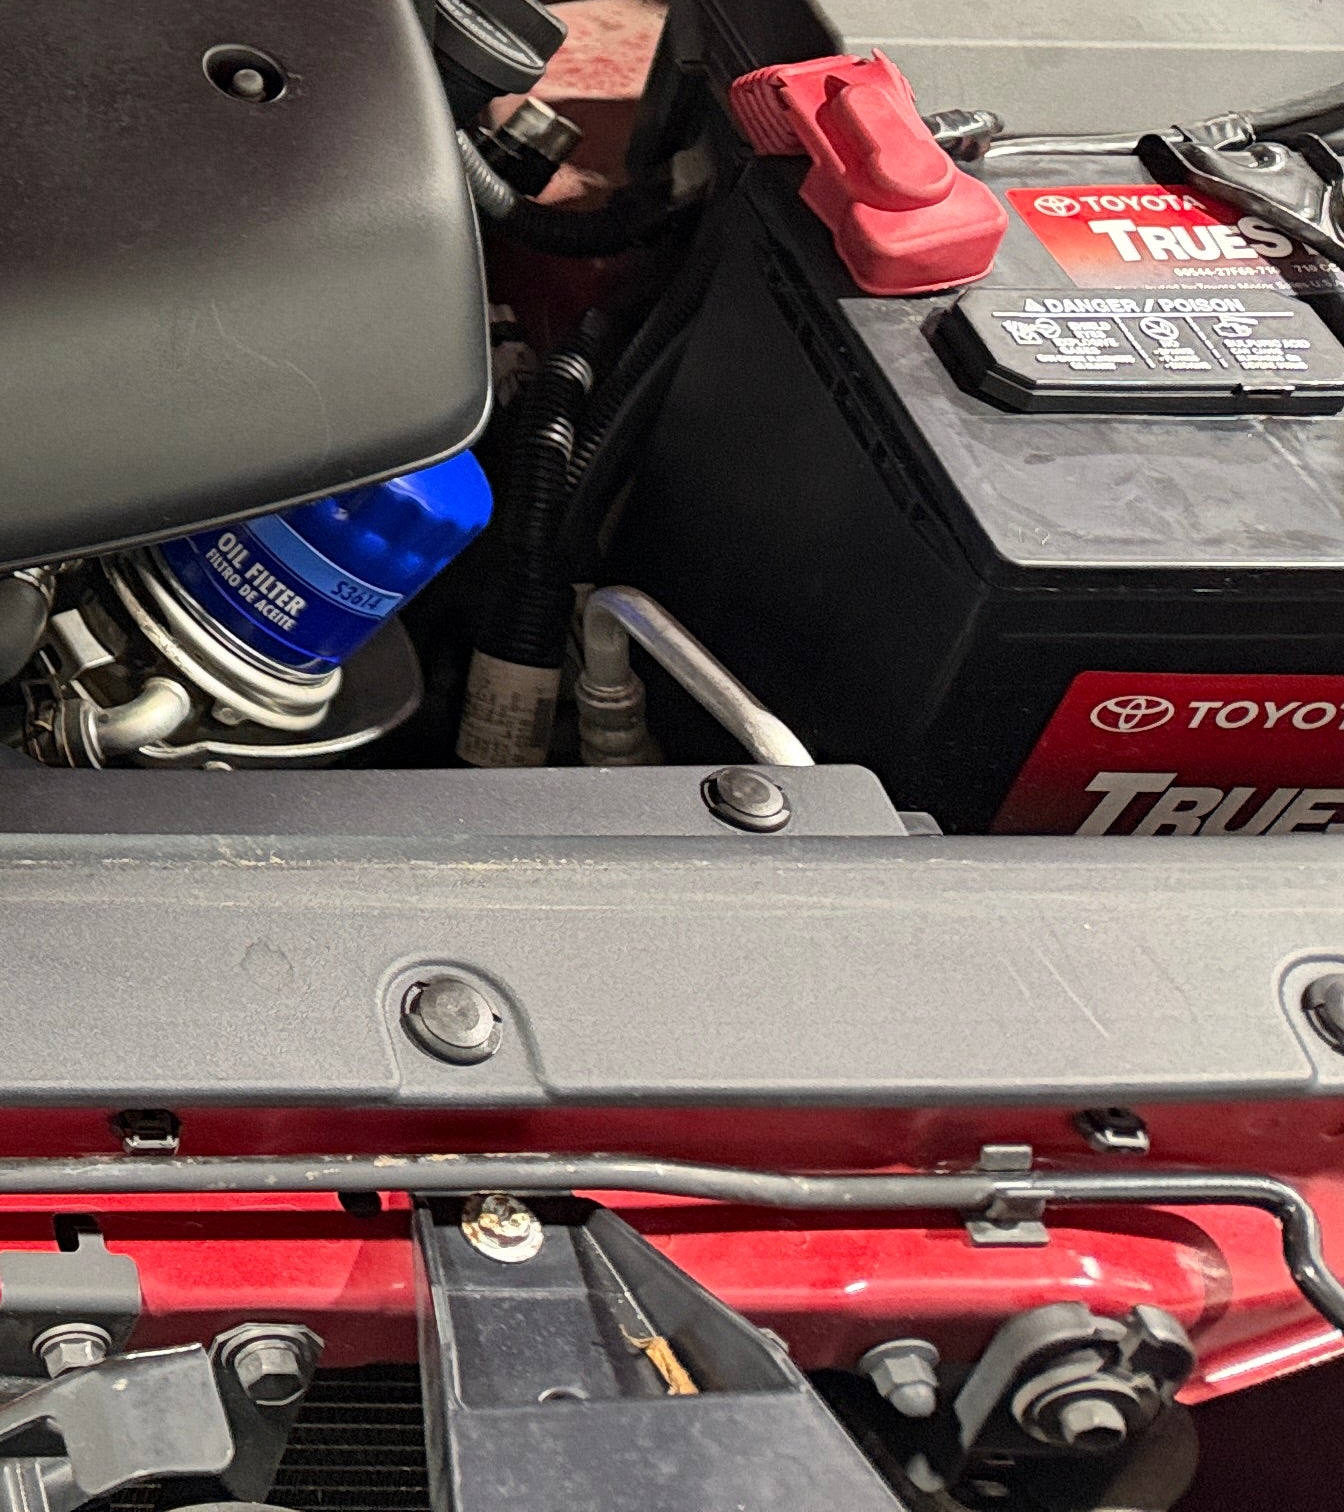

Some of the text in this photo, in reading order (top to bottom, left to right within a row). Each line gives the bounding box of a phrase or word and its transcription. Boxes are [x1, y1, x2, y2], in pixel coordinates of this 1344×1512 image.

[1080, 194, 1206, 213] TOYOTA
[1088, 216, 1318, 262] TRUES
[1043, 298, 1139, 313] DANGER
[1158, 298, 1246, 312] POISON
[205, 548, 298, 631] FILTRO DE ACEITE
[217, 532, 308, 617] OIL FILTER
[1187, 700, 1344, 730] TOYO
[1074, 772, 1344, 835] TRUE
